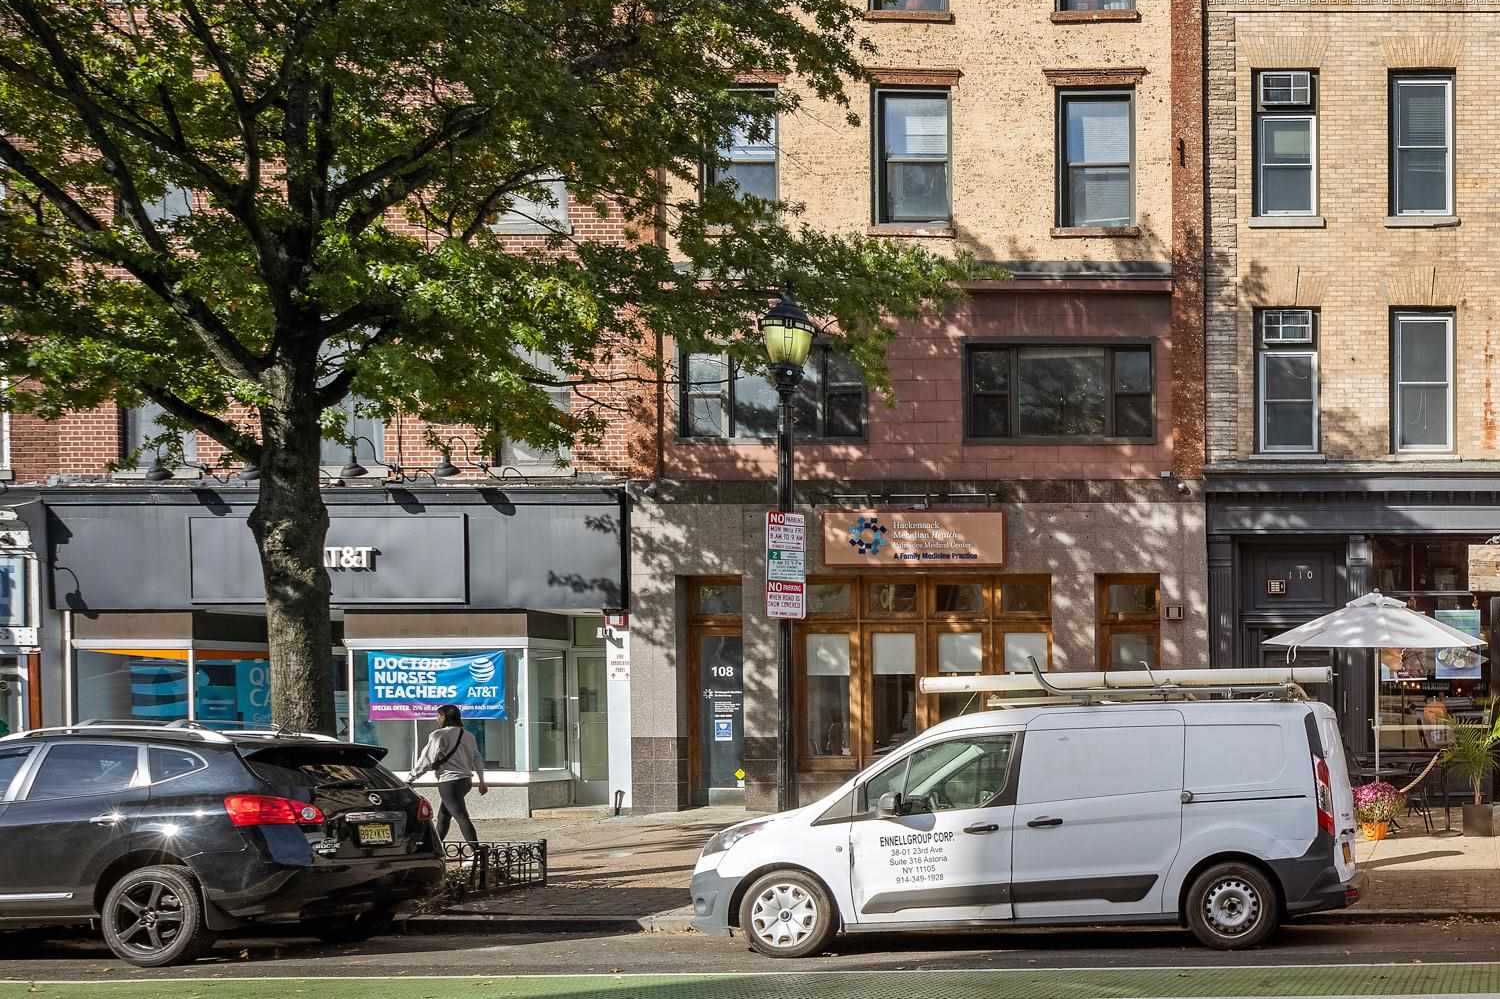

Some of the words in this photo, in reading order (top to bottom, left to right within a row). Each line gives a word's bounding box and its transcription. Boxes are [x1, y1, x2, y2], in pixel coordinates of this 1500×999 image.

[770, 513, 785, 524] NO
[893, 520, 940, 529] Hackensack
[772, 551, 778, 559] 2
[768, 581, 783, 592] NO
[374, 656, 452, 670] DOCTORS
[711, 666, 734, 677] 108
[374, 671, 437, 684] NURSES
[374, 685, 458, 699] TEACHERS
[467, 686, 499, 698] AT&T
[880, 833, 932, 847] ENNELLGROUP
[890, 848, 910, 857] 38-01
[913, 847, 929, 855] 23rd
[889, 858, 908, 866] Suite
[909, 856, 923, 865] 316
[902, 866, 914, 874] NY
[916, 864, 936, 873] 11105
